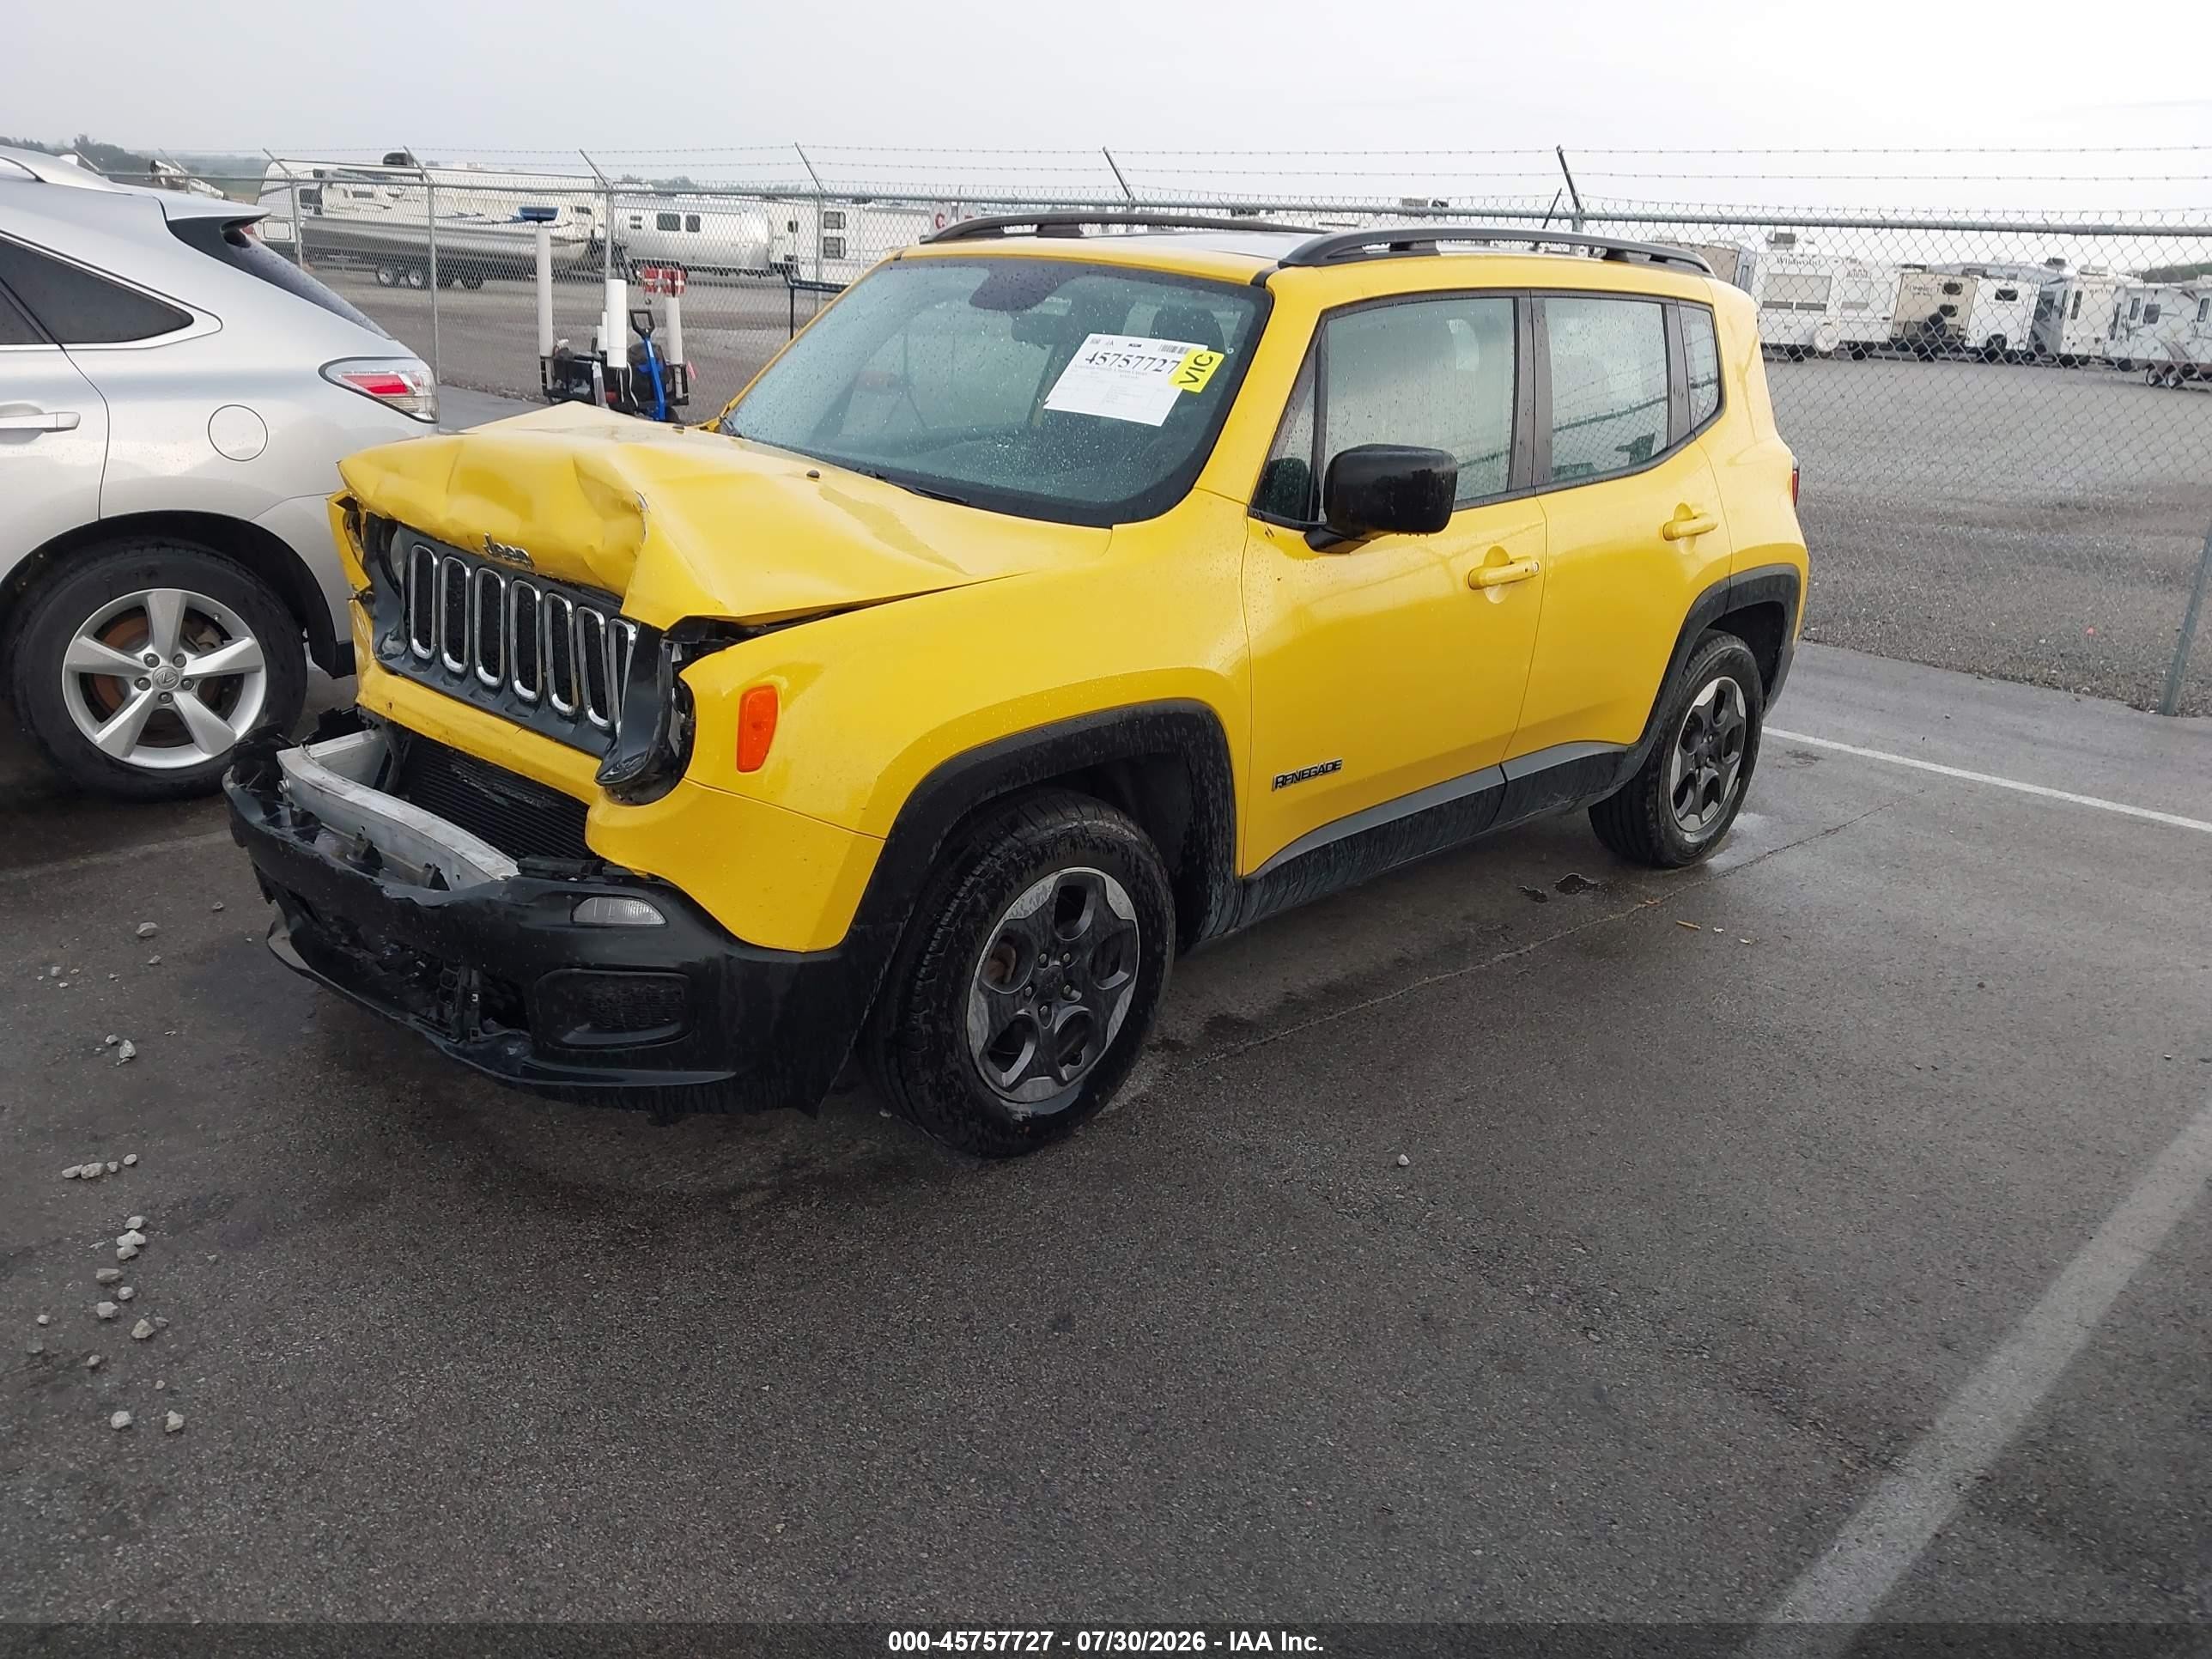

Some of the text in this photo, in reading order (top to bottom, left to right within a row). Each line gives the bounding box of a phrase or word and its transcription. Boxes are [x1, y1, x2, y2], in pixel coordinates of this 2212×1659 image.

[1085, 350, 1182, 374] 45757727
[1179, 353, 1213, 385] VIC
[483, 532, 534, 569] Jeep
[1272, 759, 1343, 791] RENEGADE
